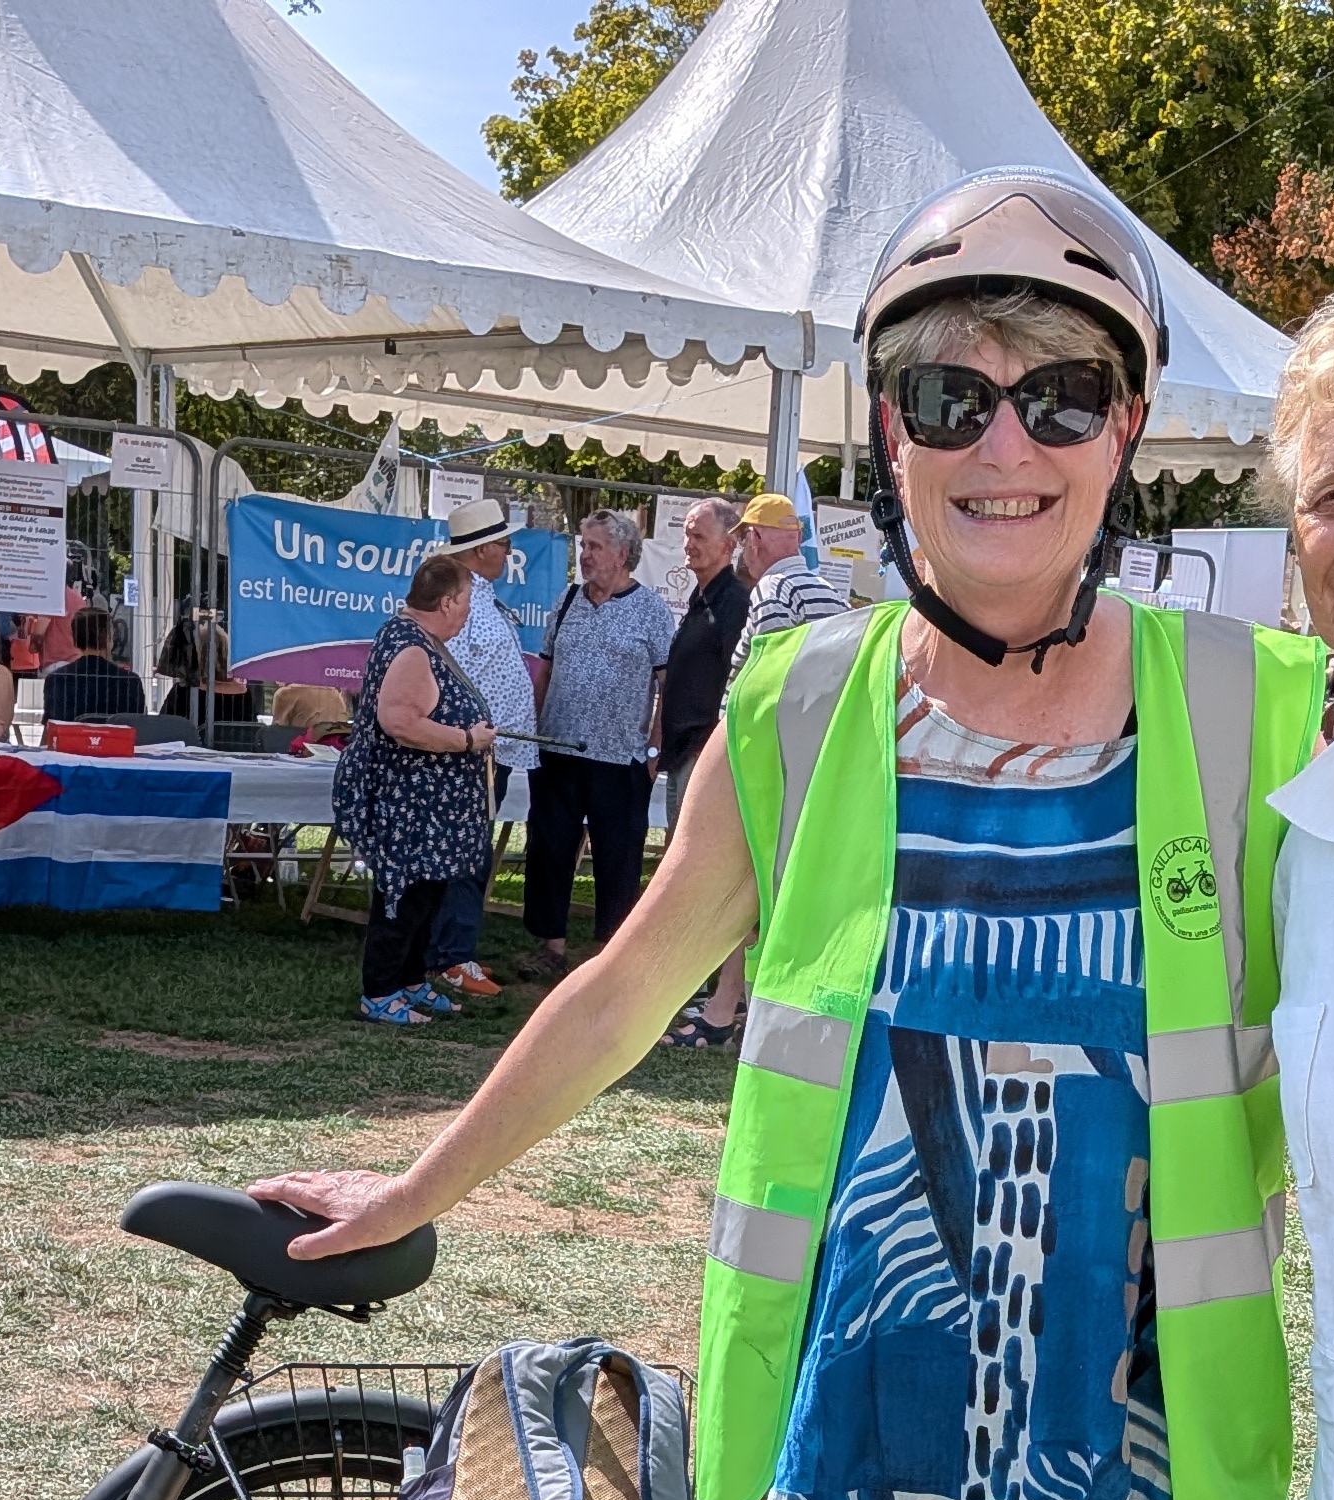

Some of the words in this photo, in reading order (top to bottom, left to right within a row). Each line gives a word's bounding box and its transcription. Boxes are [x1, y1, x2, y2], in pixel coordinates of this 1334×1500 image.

[820, 515, 865, 535] RESTAURANT
[274, 520, 325, 564] Un
[336, 538, 445, 577] souff
[239, 579, 273, 600] est
[281, 577, 375, 613] heureux
